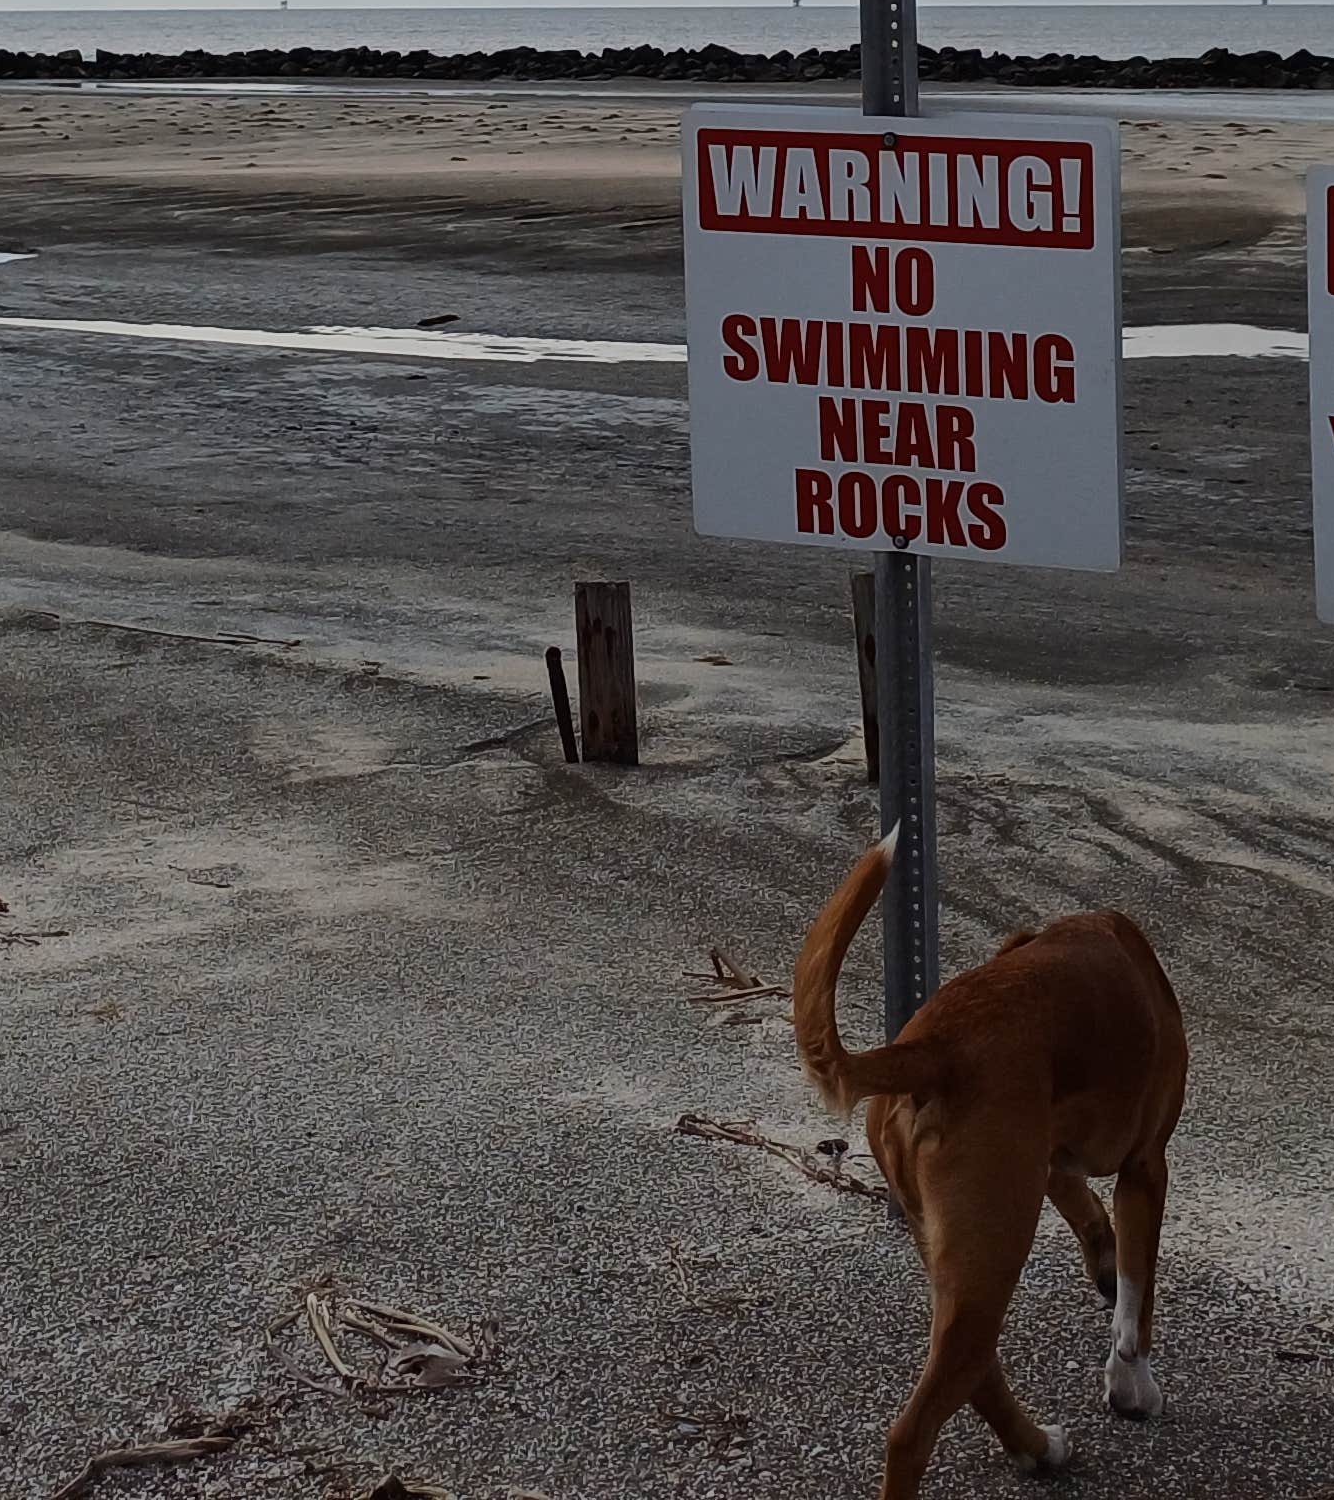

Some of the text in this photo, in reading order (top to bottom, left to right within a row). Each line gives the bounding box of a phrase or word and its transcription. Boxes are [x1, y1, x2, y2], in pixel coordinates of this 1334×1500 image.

[708, 145, 1082, 233] WARNING!
[851, 245, 934, 316] NO
[722, 314, 1076, 403] SWIMMING
[819, 397, 976, 472] NEAR
[795, 468, 1007, 550] ROCKS
